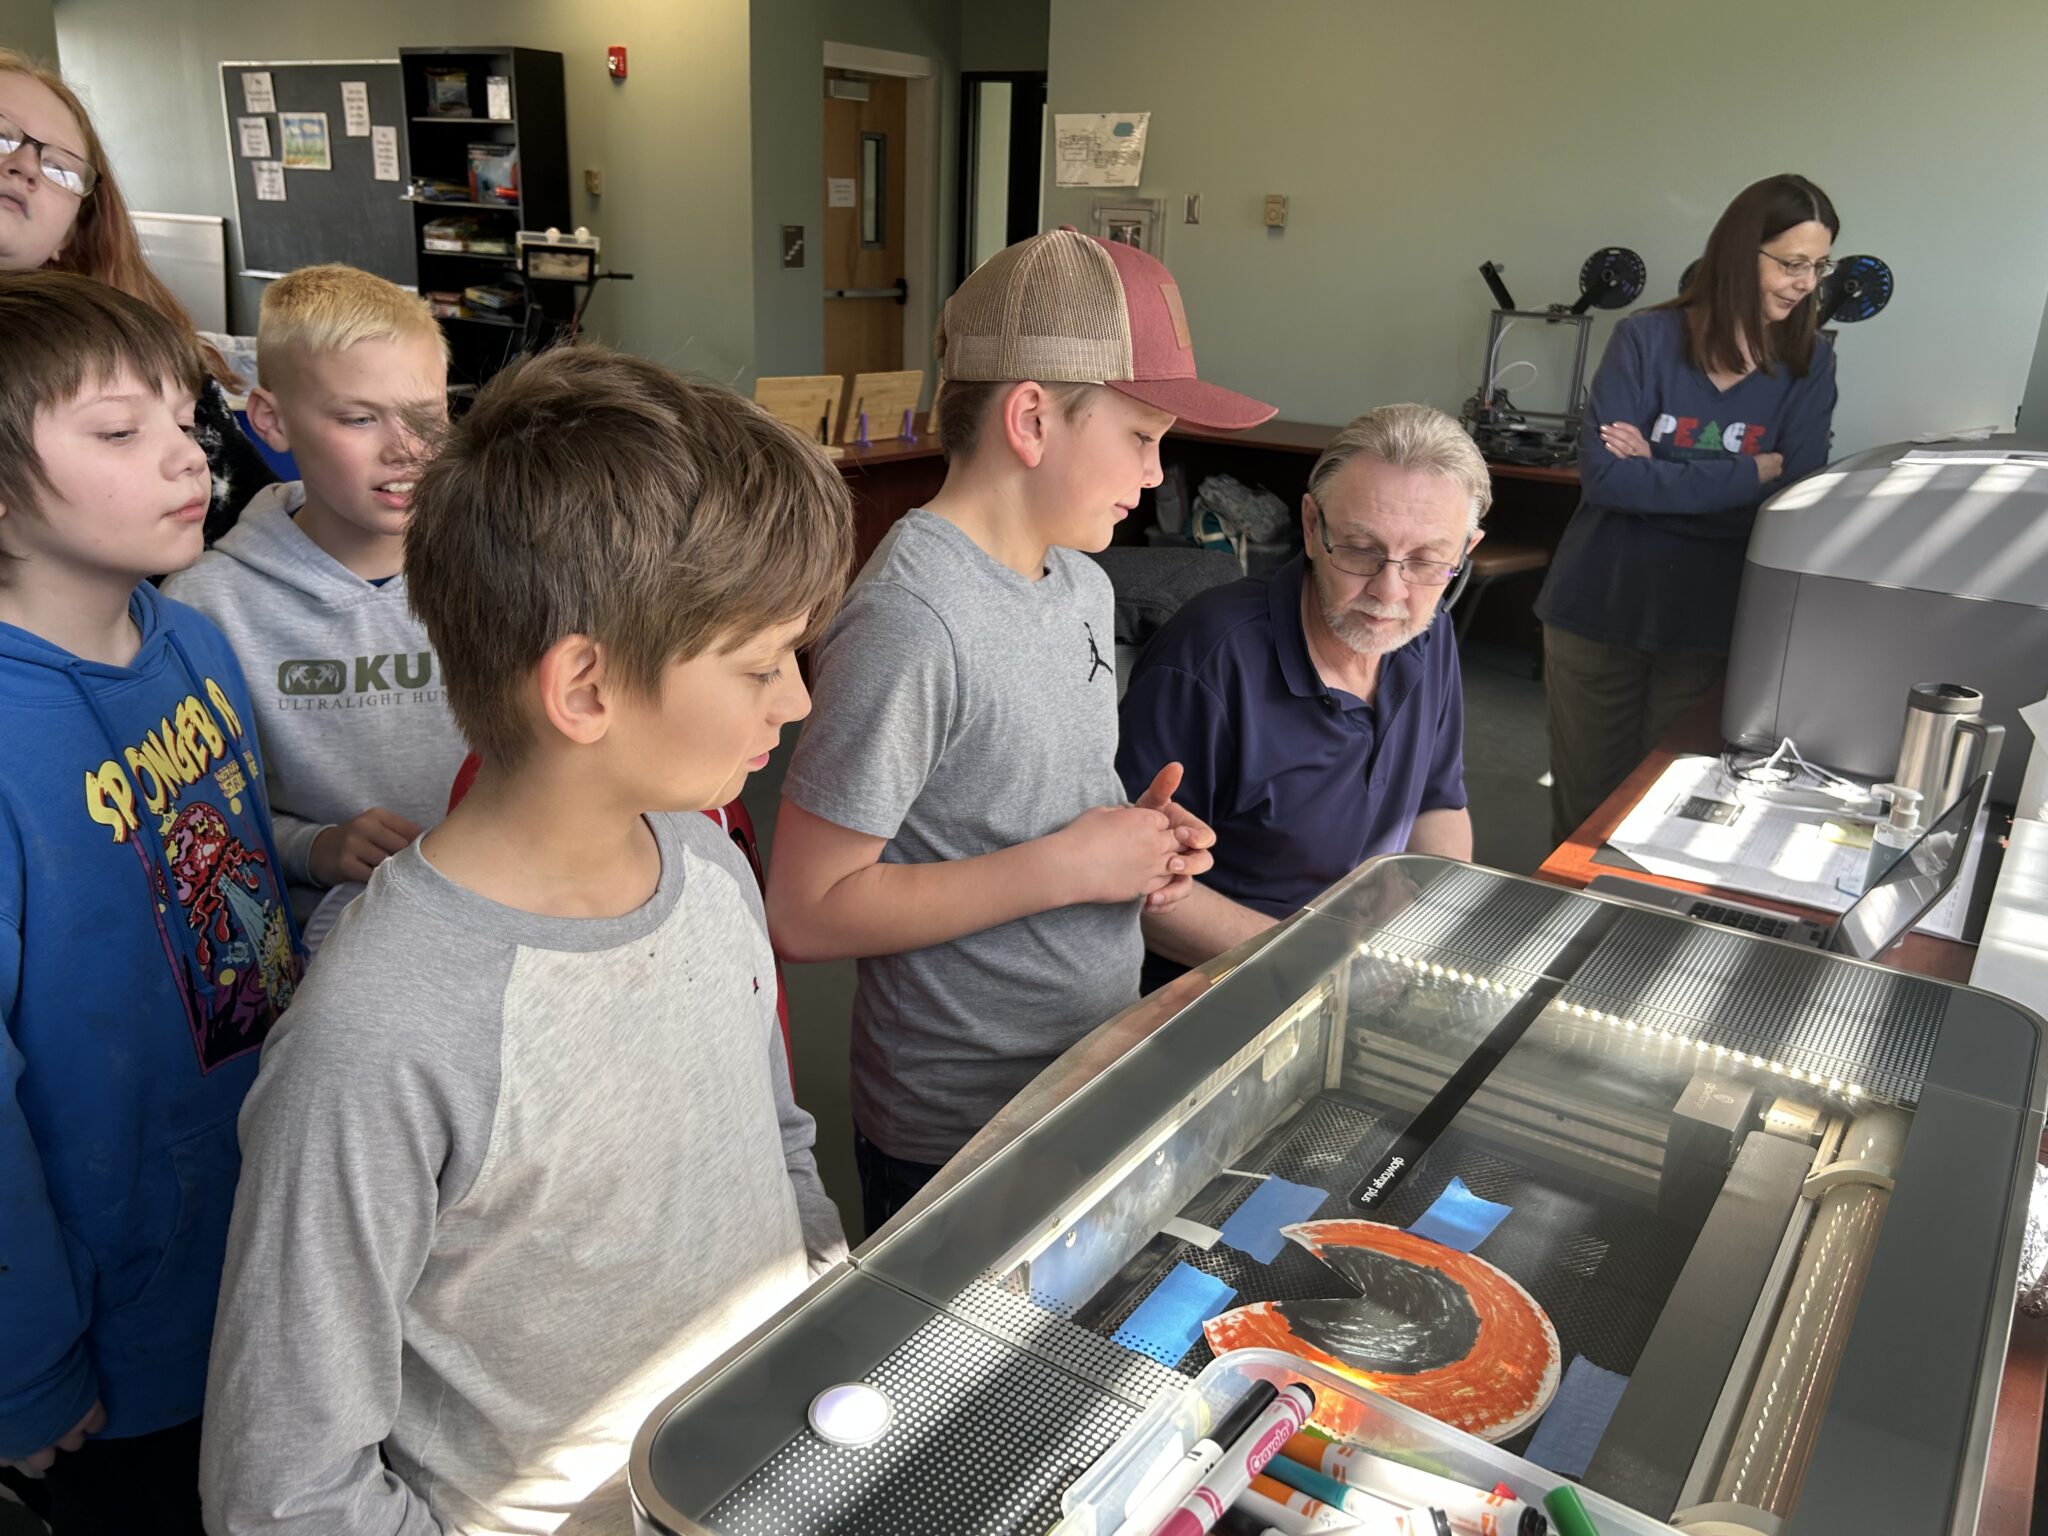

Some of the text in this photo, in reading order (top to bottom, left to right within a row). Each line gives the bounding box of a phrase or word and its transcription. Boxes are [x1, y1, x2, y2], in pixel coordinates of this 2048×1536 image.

[278, 692, 405, 711] ULTRALIGHT
[86, 677, 245, 843] SPONGEBB
[1361, 1156, 1405, 1202] glowforge plus
[1250, 1427, 1290, 1473] Crayola
